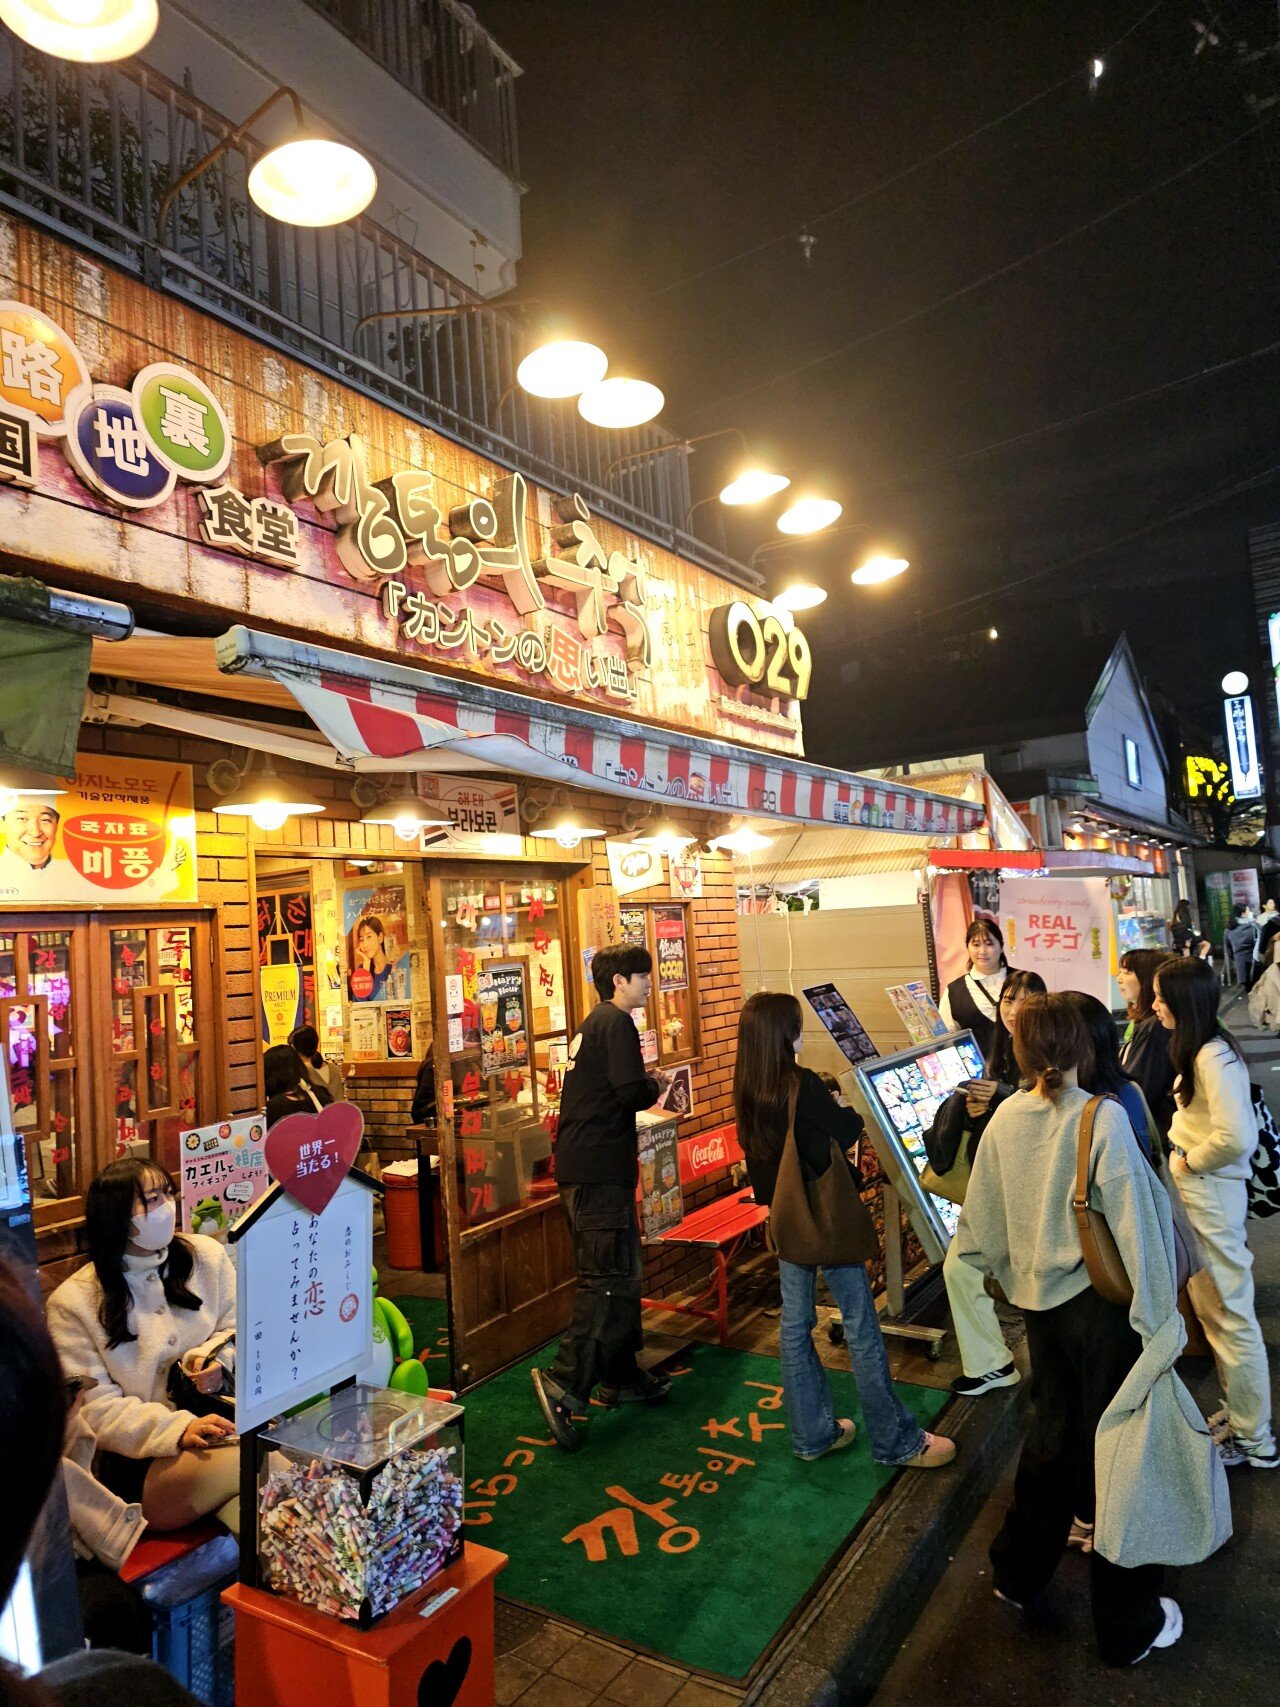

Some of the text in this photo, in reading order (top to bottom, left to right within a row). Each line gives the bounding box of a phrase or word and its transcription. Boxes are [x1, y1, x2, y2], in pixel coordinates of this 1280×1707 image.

[206, 490, 298, 559] 食堂
[388, 581, 637, 698] 「カントンの思い出」
[727, 601, 812, 700] 029
[458, 791, 484, 807] 해태
[80, 820, 149, 836] 국자표
[447, 807, 498, 833] 부라보콘
[82, 847, 153, 879] 미풍
[1028, 914, 1077, 931] REAL
[1024, 932, 1083, 950] イチゴ
[493, 975, 522, 988] Happy
[264, 988, 296, 1003] PREMIUM
[498, 986, 520, 996] Hour
[650, 1127, 676, 1144] Happy
[299, 1138, 336, 1160] 世界一
[655, 1140, 673, 1152] Hour
[692, 1137, 726, 1169] Coca-Cola
[192, 1174, 228, 1189] フィギュア
